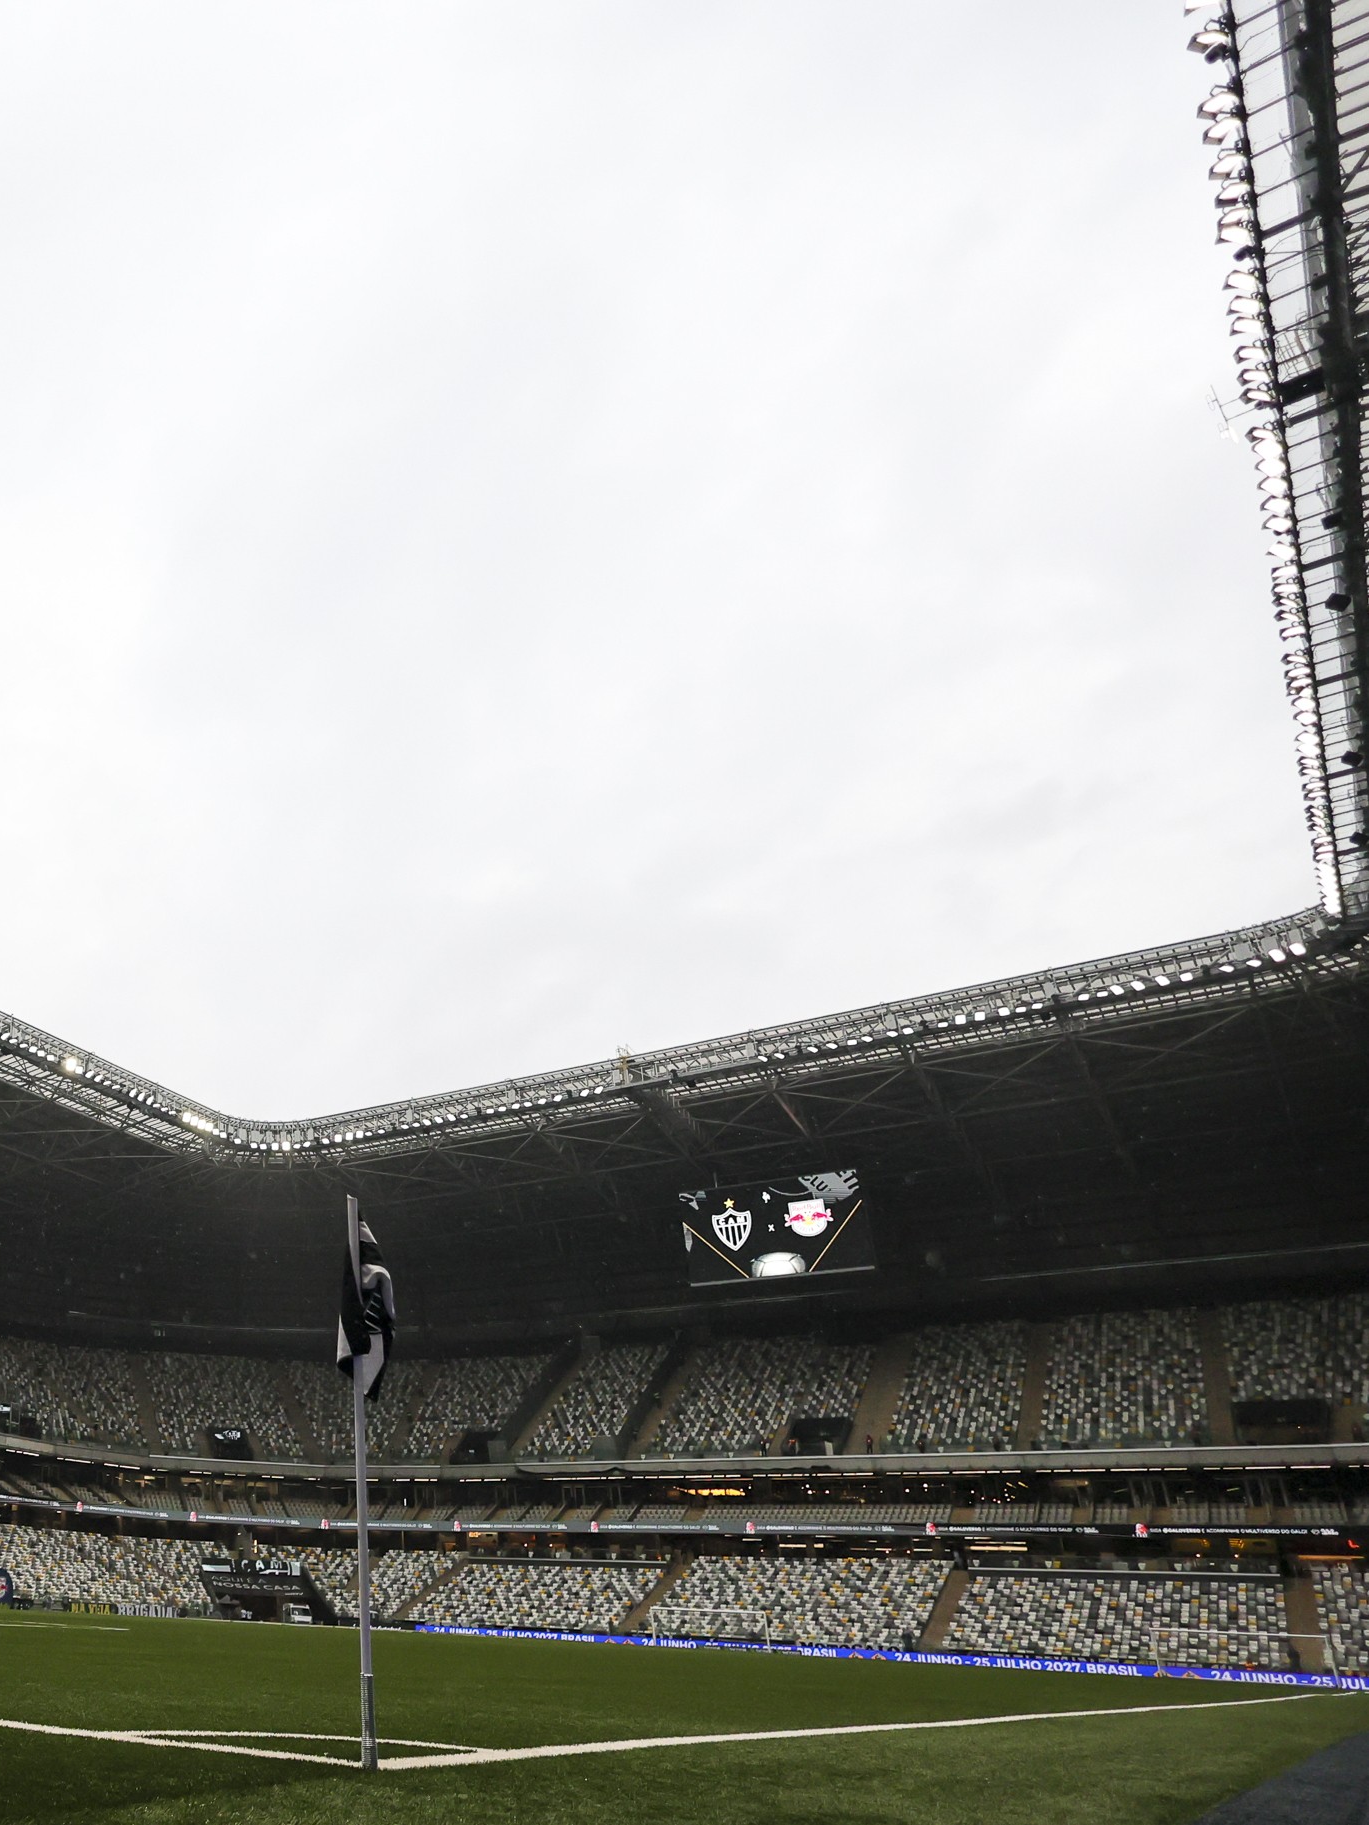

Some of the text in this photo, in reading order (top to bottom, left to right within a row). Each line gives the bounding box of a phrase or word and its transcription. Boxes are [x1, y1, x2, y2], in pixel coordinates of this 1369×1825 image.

[719, 1215, 745, 1225] CAM
[212, 1580, 261, 1590] NOSSA
[894, 1652, 912, 1662] 24
[913, 1654, 962, 1665] JUNHO
[973, 1656, 990, 1667] 25
[992, 1658, 1042, 1671] JULHO
[1044, 1660, 1084, 1673] 2027.
[1086, 1663, 1143, 1677] BRASIL
[1210, 1671, 1233, 1681] 24
[1235, 1672, 1297, 1685] JUNHO
[1310, 1675, 1333, 1687] 25
